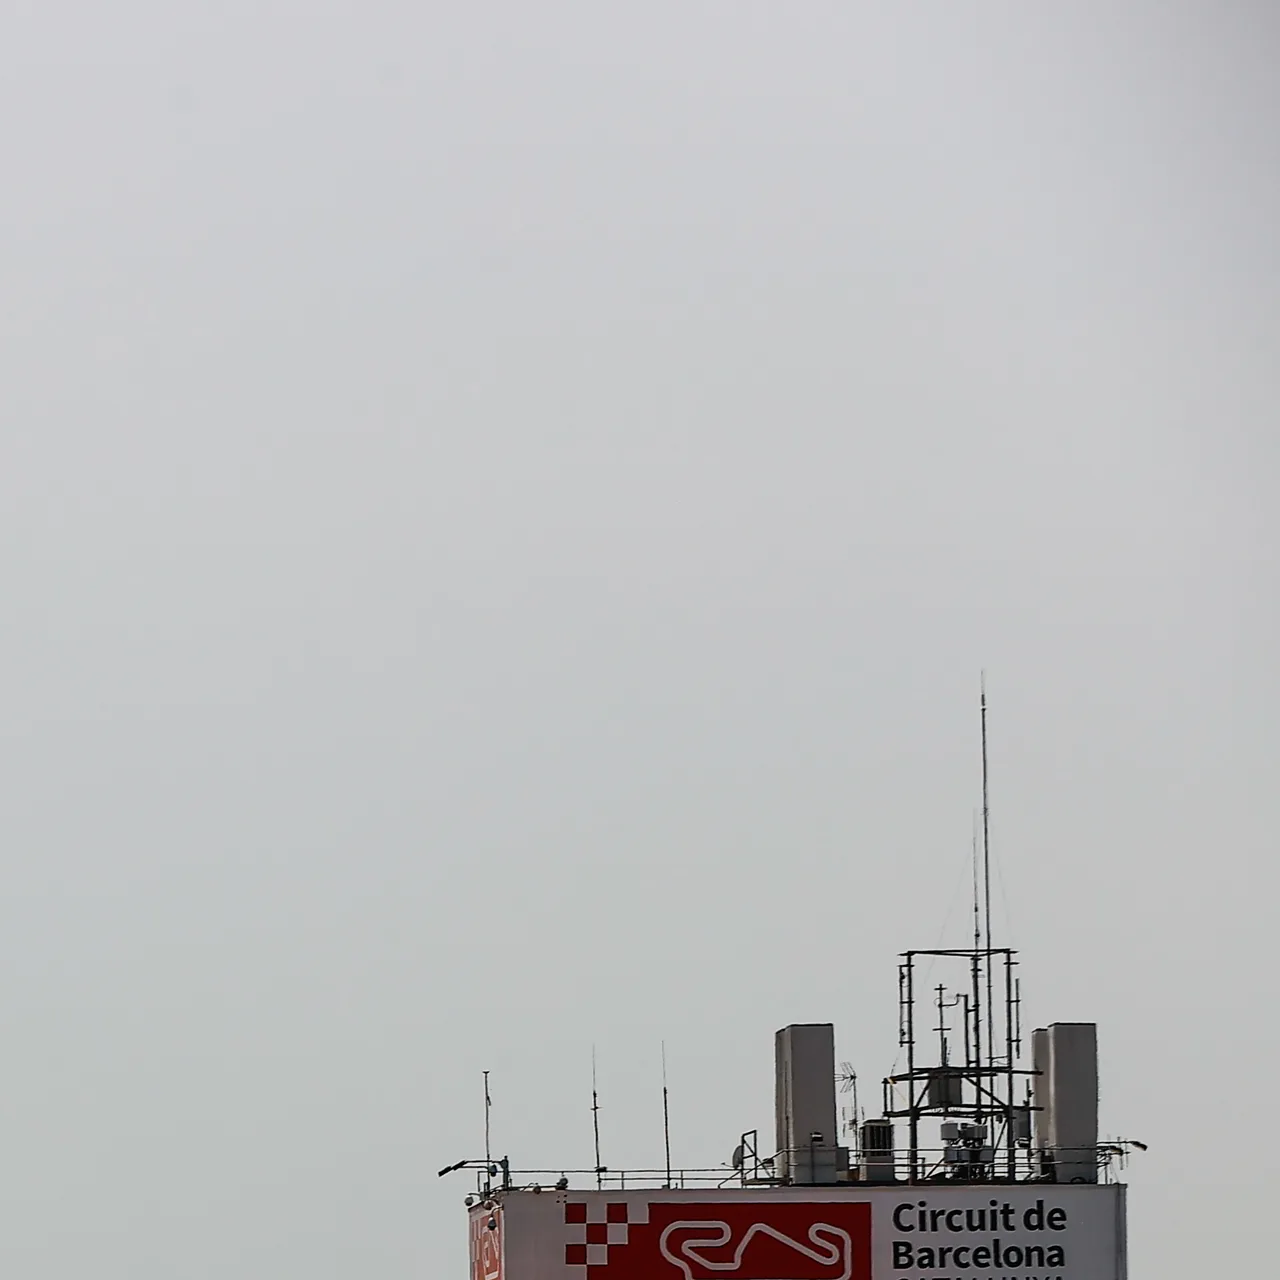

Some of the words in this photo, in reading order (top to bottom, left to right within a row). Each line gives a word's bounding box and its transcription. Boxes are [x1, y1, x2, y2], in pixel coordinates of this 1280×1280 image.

[892, 1200, 1015, 1232] Circuit
[1023, 1200, 1067, 1232] de
[892, 1239, 1065, 1269] Barcelona
